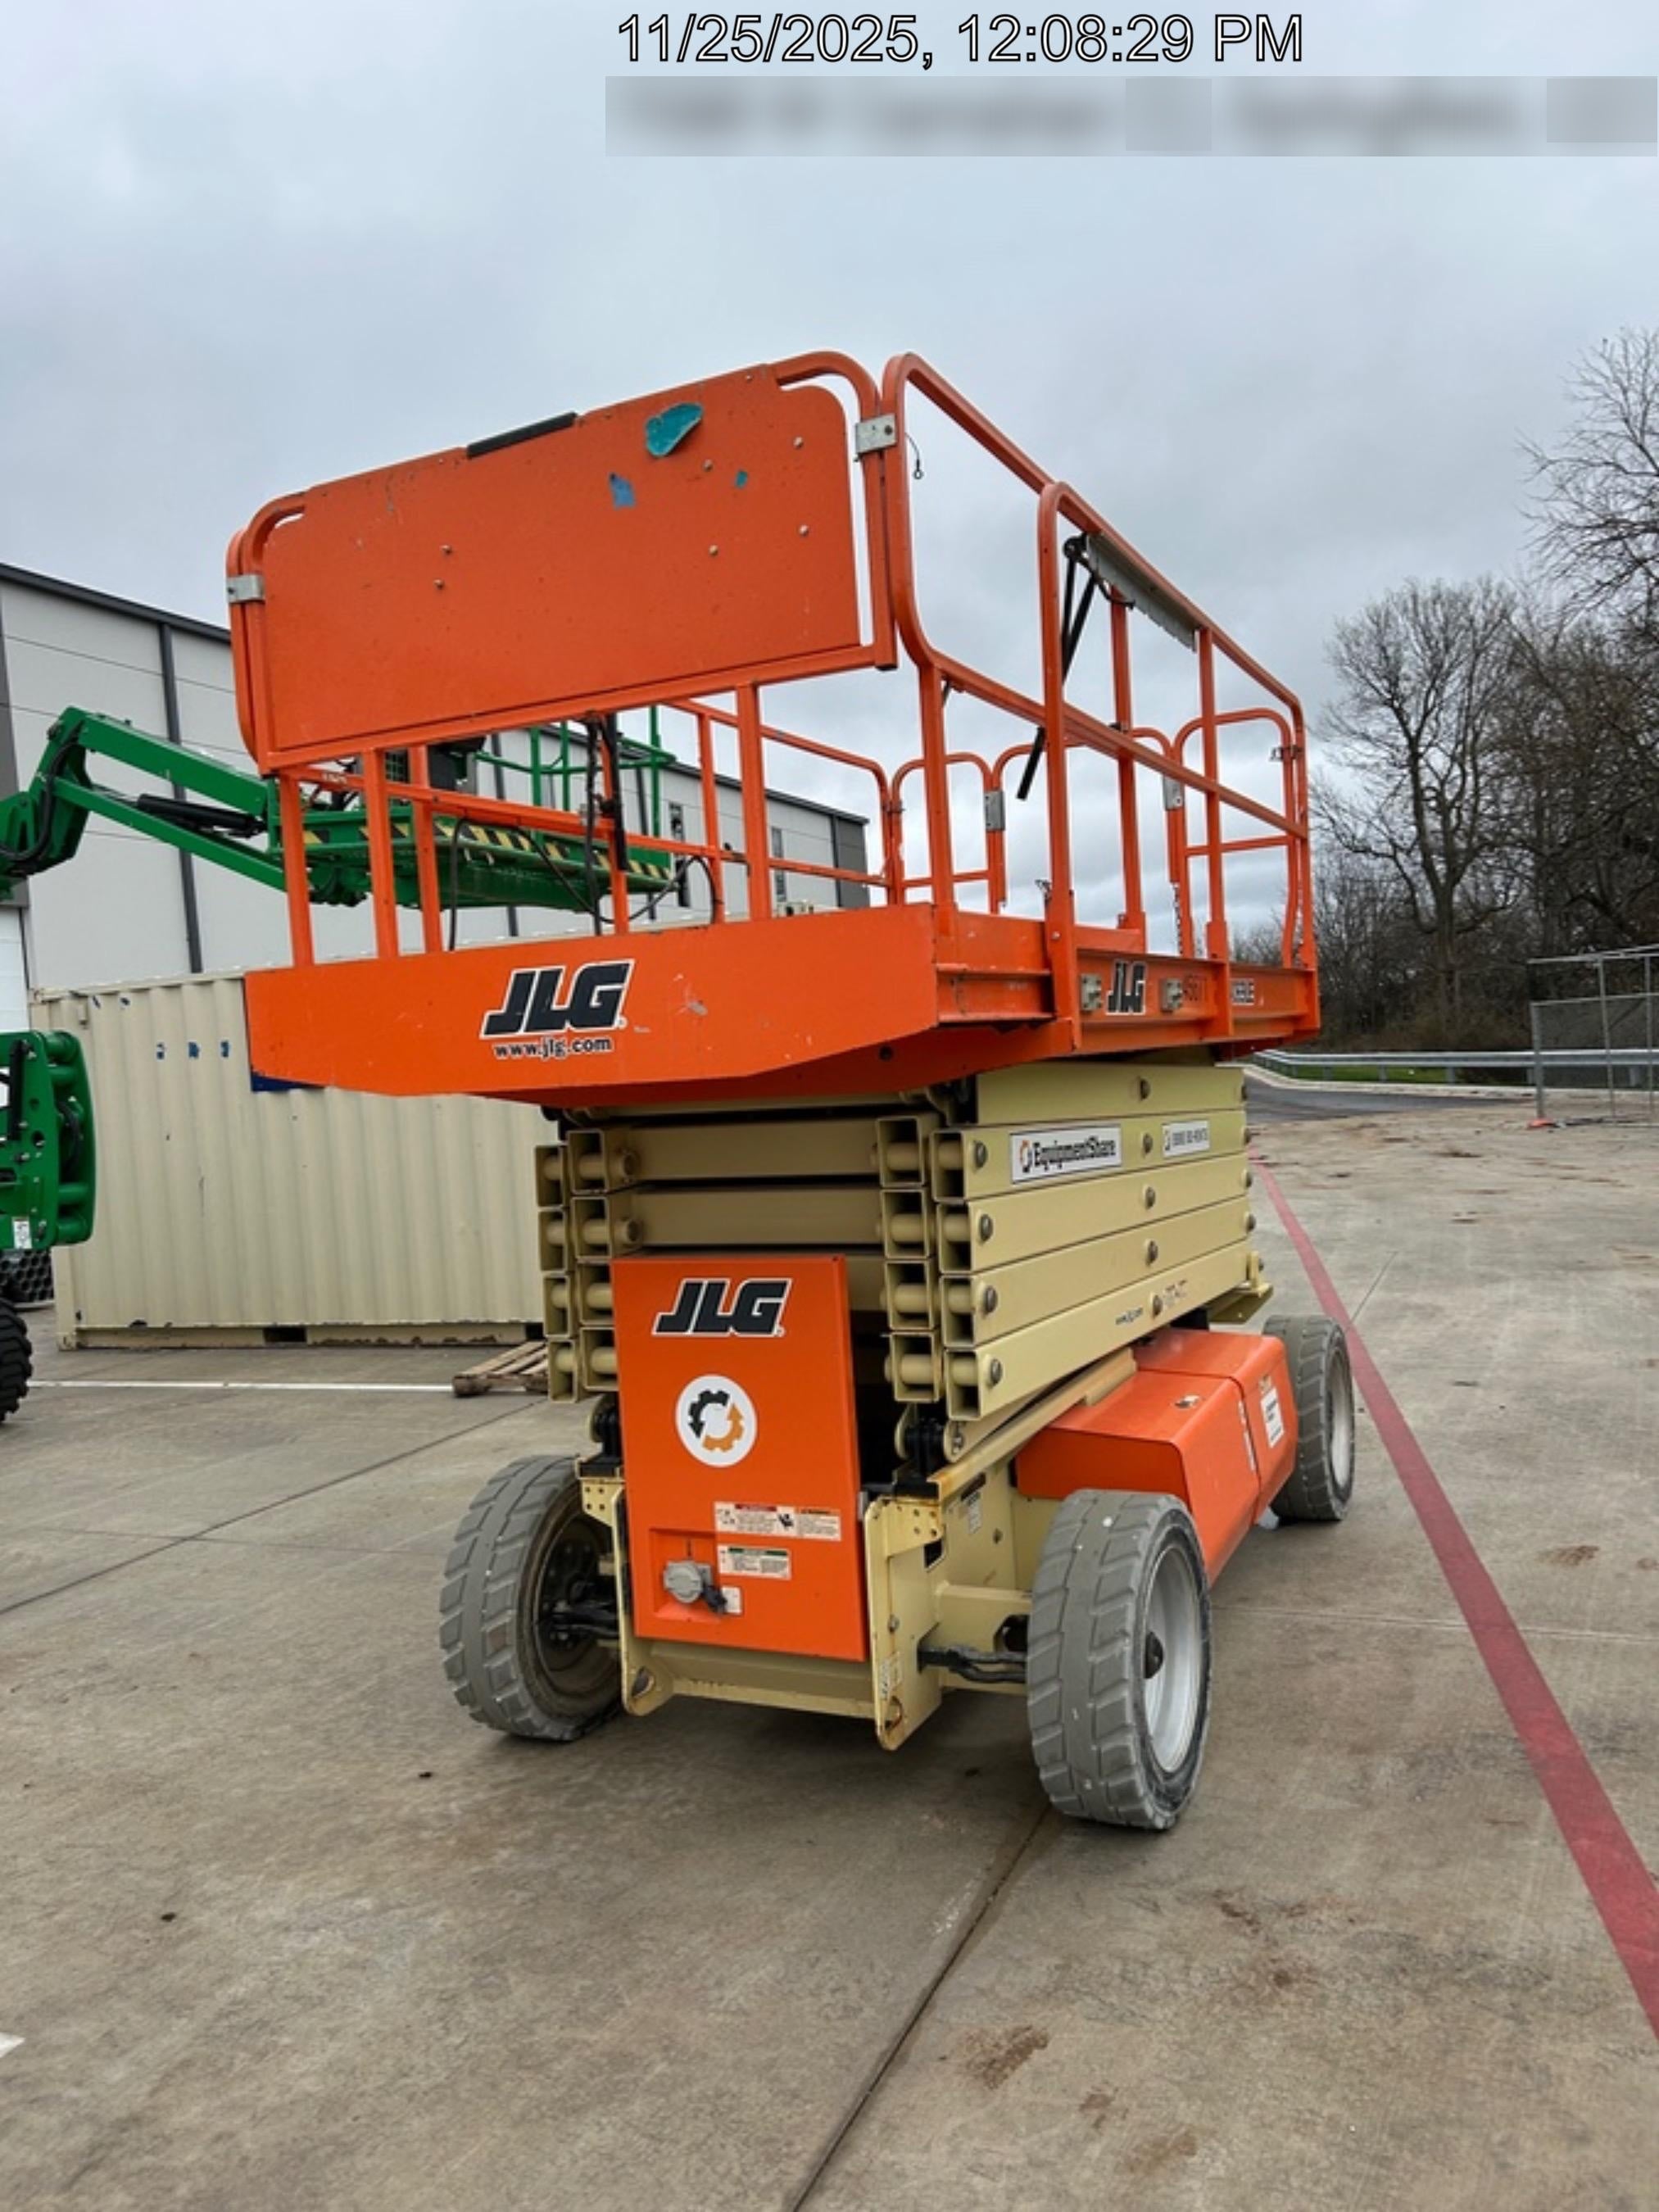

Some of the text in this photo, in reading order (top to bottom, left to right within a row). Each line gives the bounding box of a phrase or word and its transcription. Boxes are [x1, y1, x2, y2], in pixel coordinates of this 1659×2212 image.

[481, 960, 632, 1038] JLG
[1106, 959, 1148, 1016] JLG
[493, 1038, 613, 1060] www.jlg.com
[653, 1278, 791, 1337] JLG
